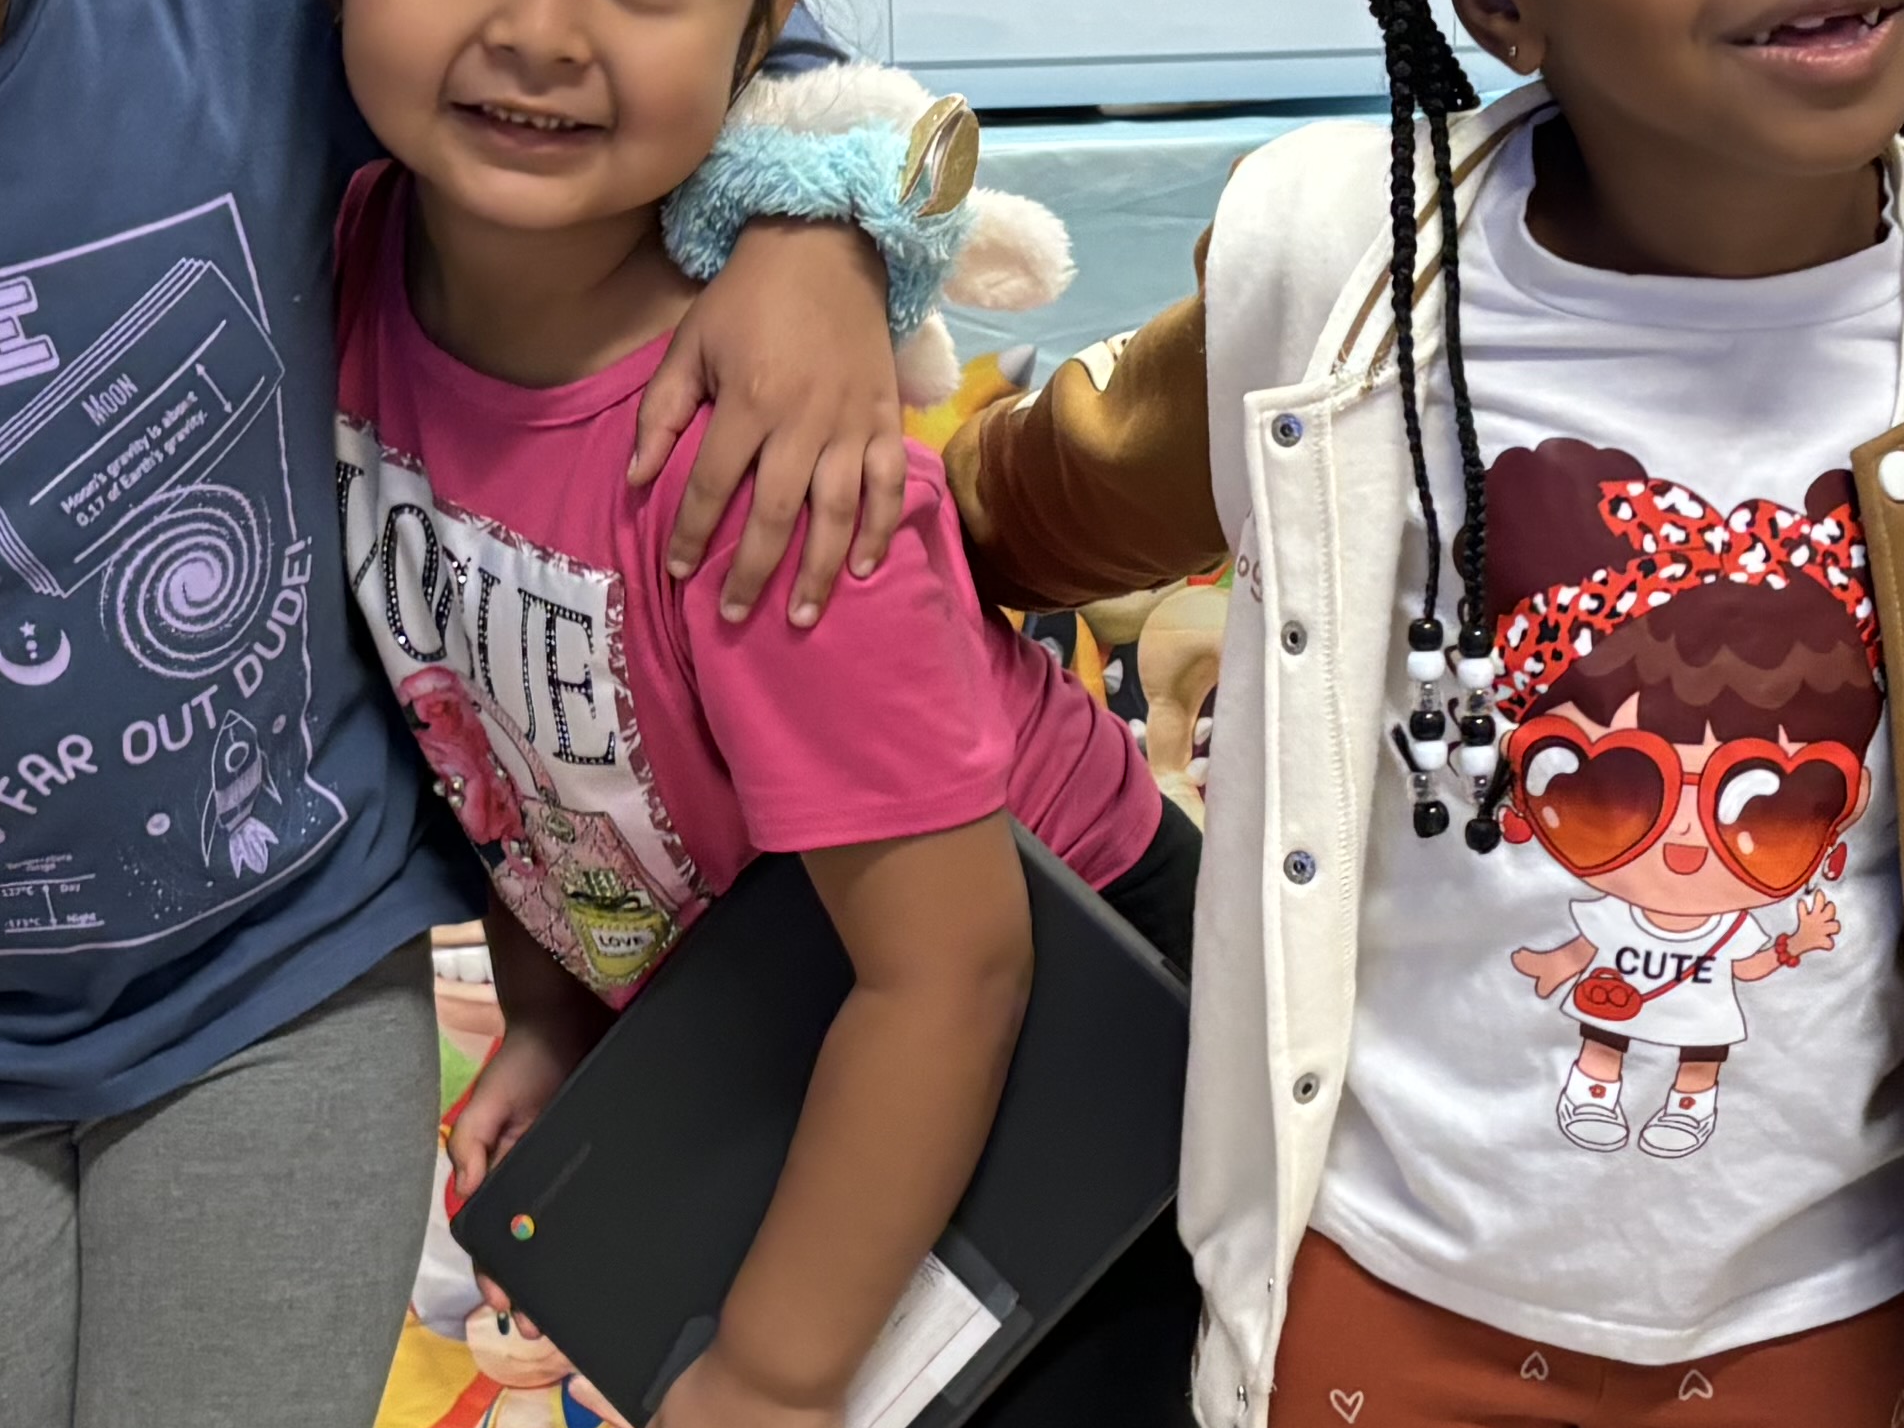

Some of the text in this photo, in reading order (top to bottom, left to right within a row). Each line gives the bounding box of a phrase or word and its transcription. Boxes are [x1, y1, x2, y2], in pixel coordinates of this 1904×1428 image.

[81, 373, 138, 426] MOON
[60, 391, 198, 515] Moon's gravity is about
[107, 482, 121, 503] of
[119, 450, 164, 490] Earth's
[122, 683, 221, 765] OUT
[232, 535, 315, 700] DUDE!
[1614, 945, 1717, 985] CUTE
